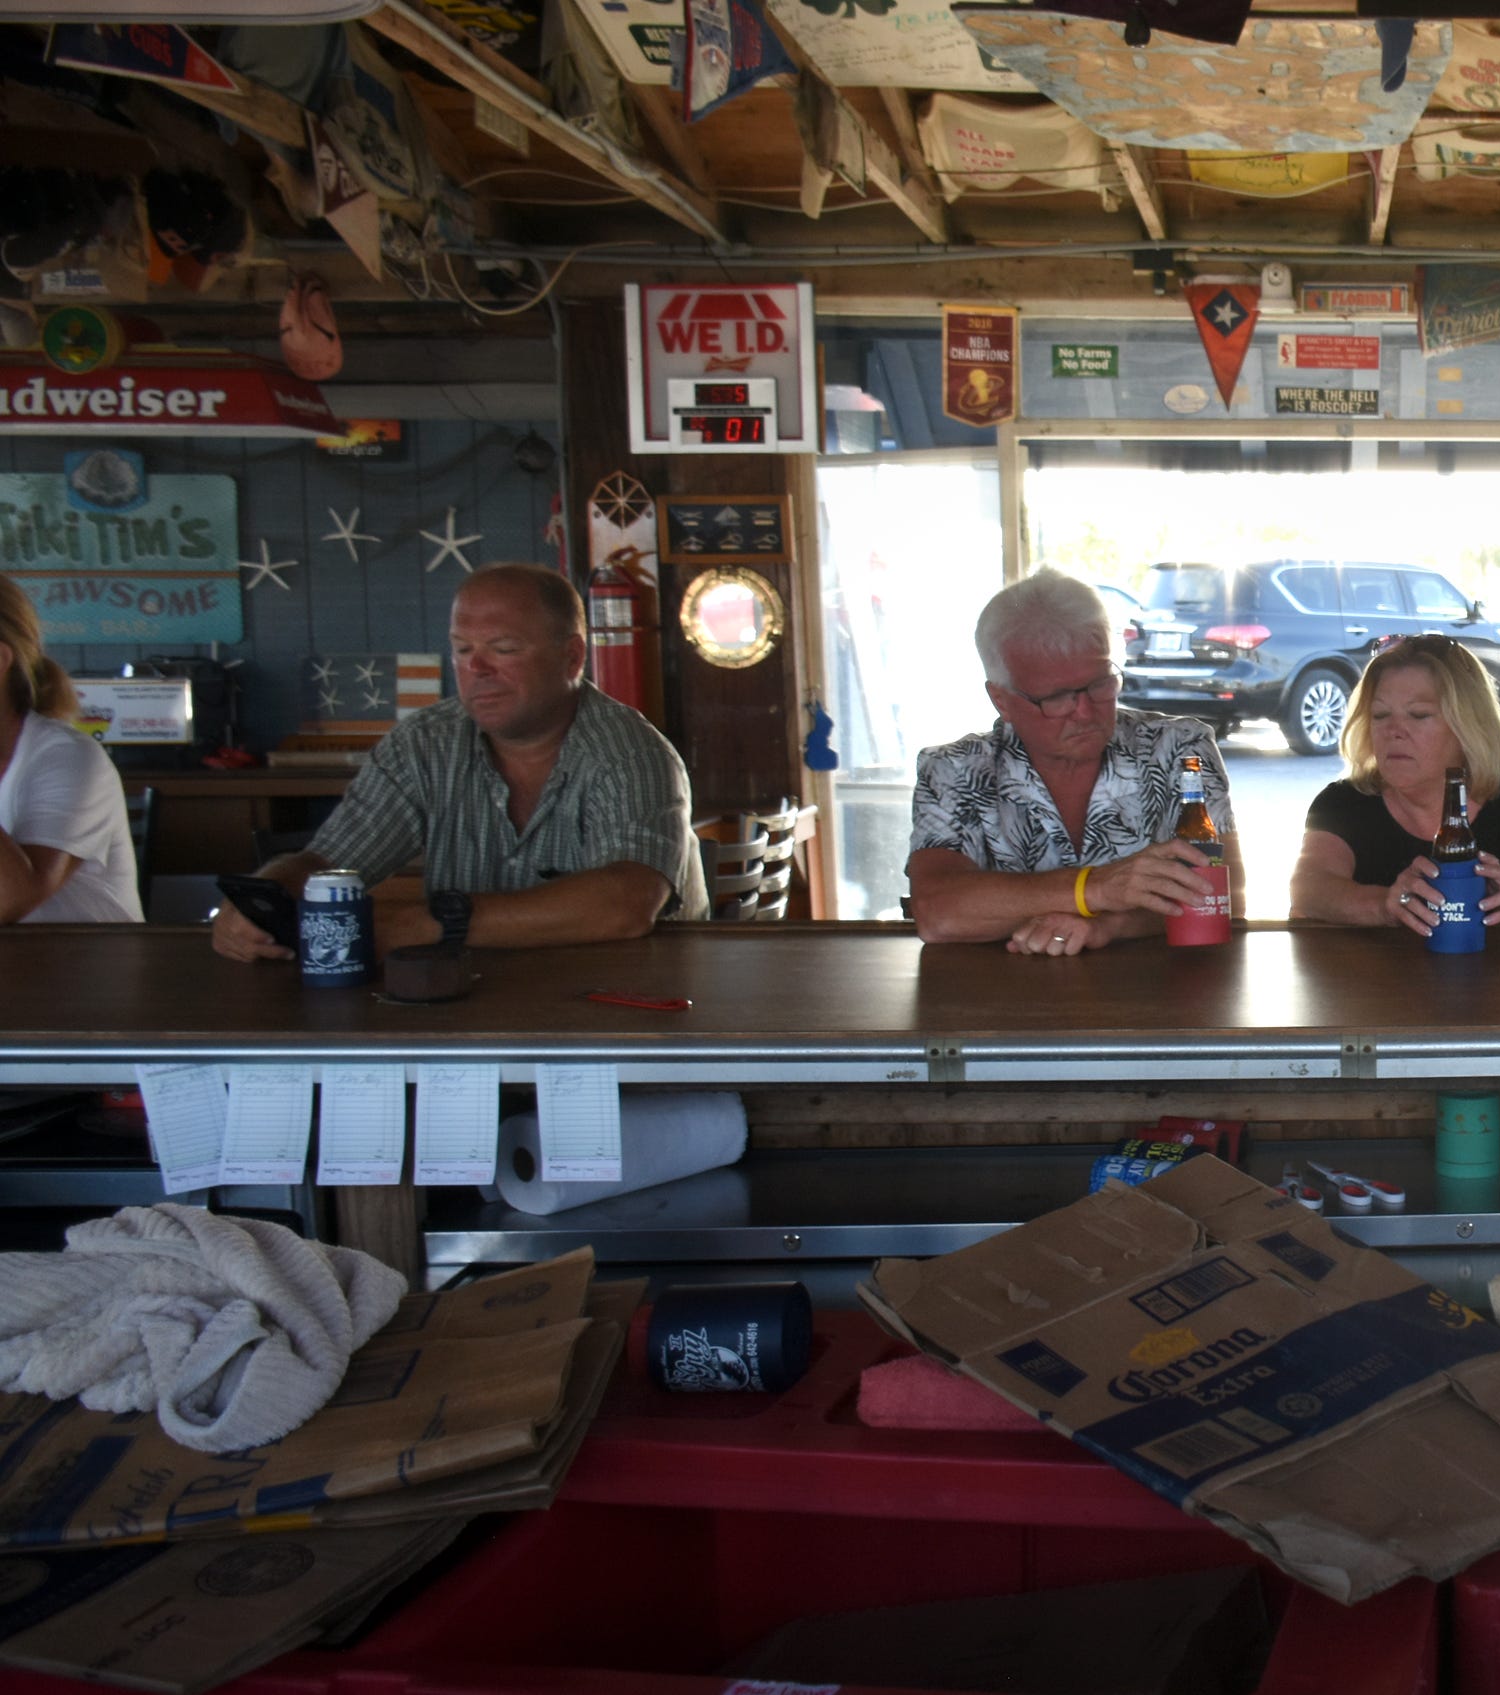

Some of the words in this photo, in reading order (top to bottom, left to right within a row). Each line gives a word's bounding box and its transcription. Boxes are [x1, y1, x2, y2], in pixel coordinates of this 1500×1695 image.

[1331, 290, 1388, 307] FLORIDA
[657, 321, 722, 353] WE
[735, 321, 789, 353] I.D.
[968, 335, 991, 349] NBA
[949, 349, 1011, 363] CHAMPIONS
[1058, 348, 1075, 359] No
[1077, 347, 1112, 359] Farms
[1062, 359, 1078, 370] No
[1081, 359, 1109, 370] Food
[1279, 388, 1319, 401] WHERE
[1323, 388, 1345, 401] THE
[1349, 390, 1377, 402] HELL
[1294, 400, 1306, 412] IS
[1310, 401, 1362, 414] ROSCOE?
[1107, 1327, 1268, 1403] Corona
[1179, 1364, 1278, 1407] Extra
